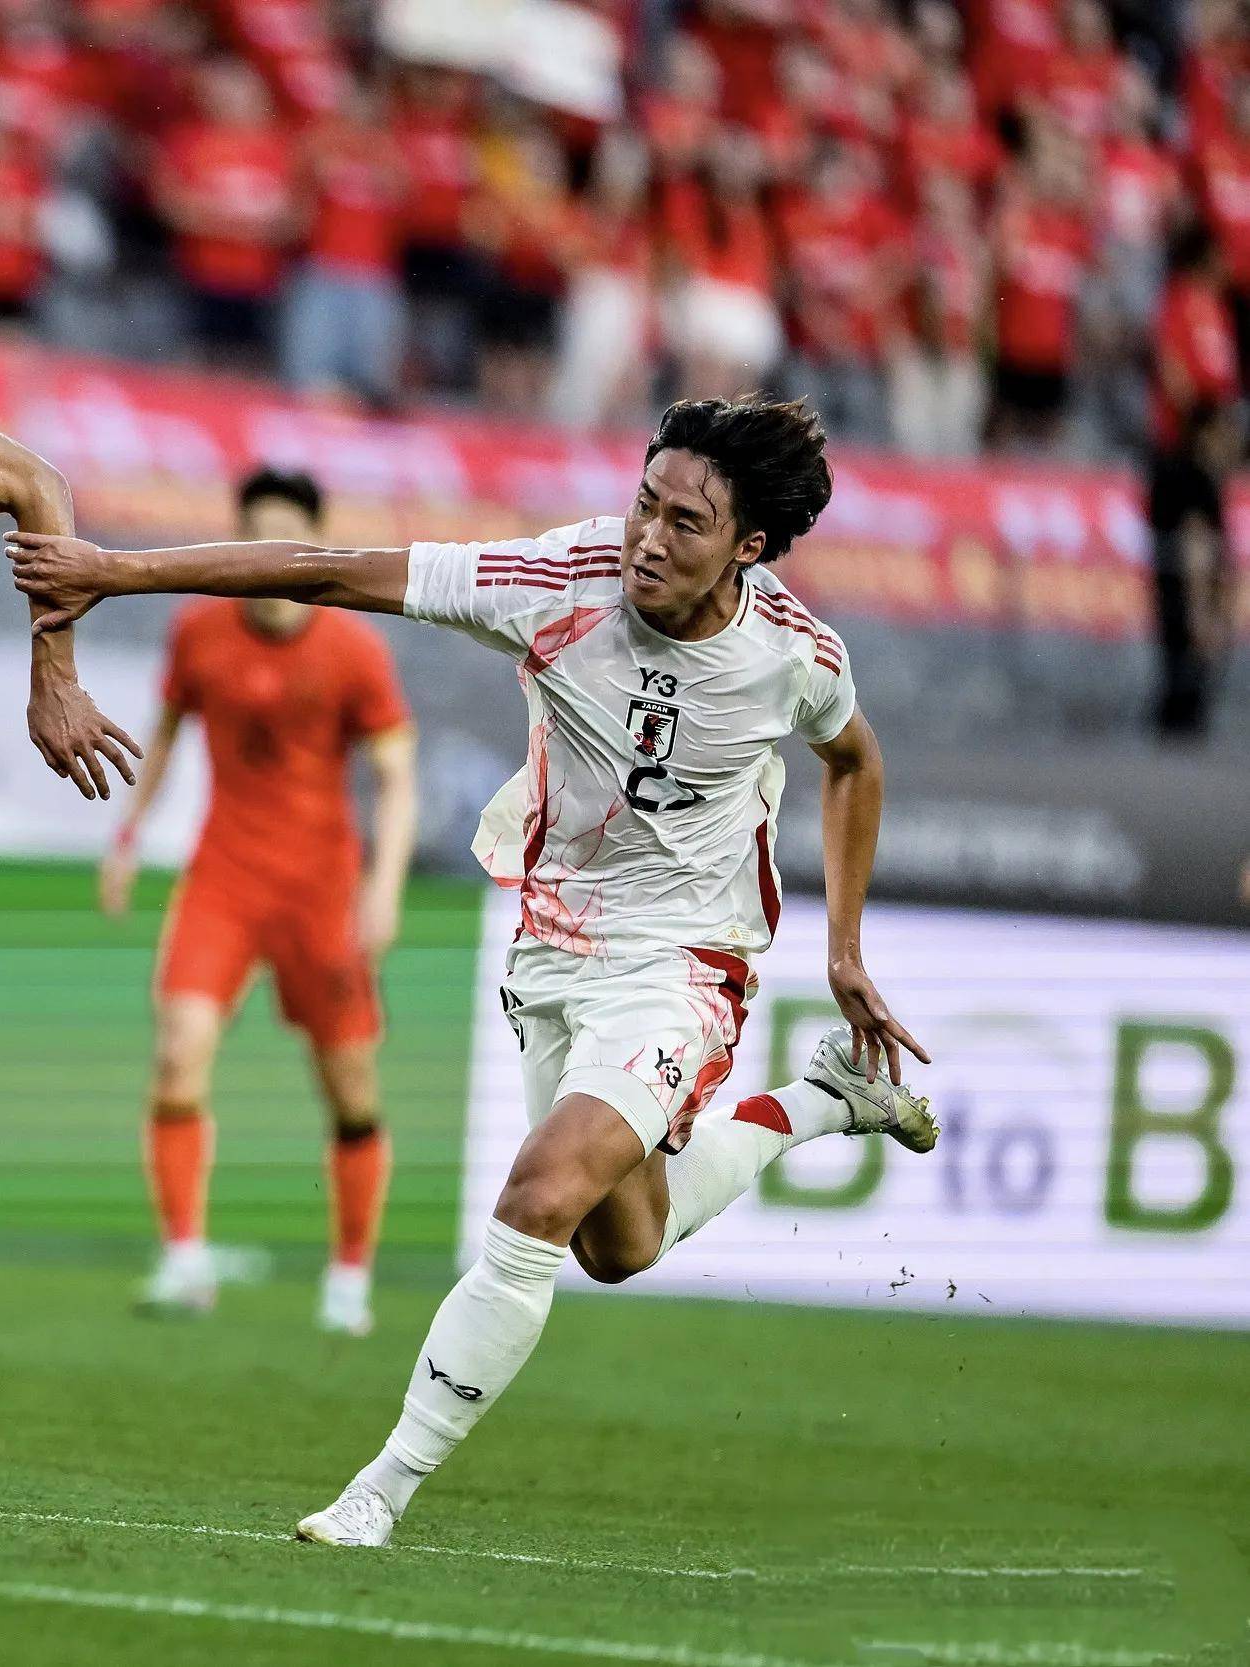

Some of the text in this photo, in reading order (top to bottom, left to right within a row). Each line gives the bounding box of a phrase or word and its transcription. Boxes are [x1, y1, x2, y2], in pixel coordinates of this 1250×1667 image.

[639, 667, 678, 698] Y-3
[641, 702, 669, 714] JAPAN
[654, 1047, 682, 1089] Y-3
[427, 1356, 483, 1401] Y-3
